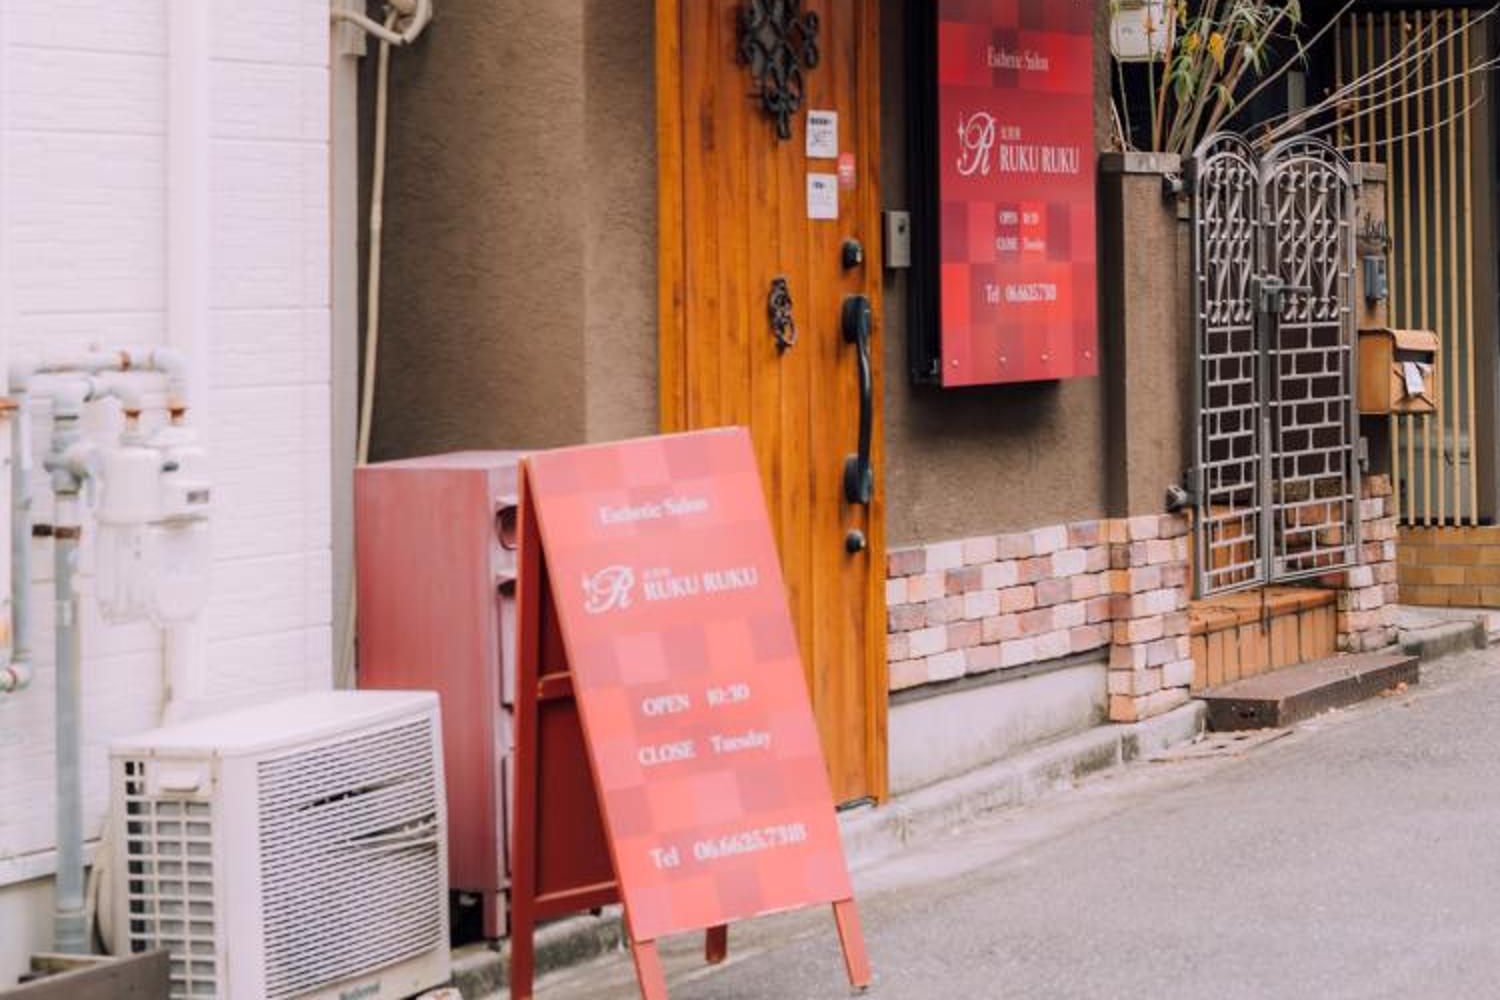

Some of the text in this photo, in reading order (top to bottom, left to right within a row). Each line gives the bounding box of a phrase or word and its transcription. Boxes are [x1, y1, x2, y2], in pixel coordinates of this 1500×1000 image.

[1000, 143, 1079, 175] RUKU RUKU
[642, 573, 700, 601] RUKU
[702, 564, 758, 593] RUKU
[641, 692, 691, 717] OPEN
[638, 728, 771, 767] CLOSE Tuesday
[647, 845, 682, 871] Tel
